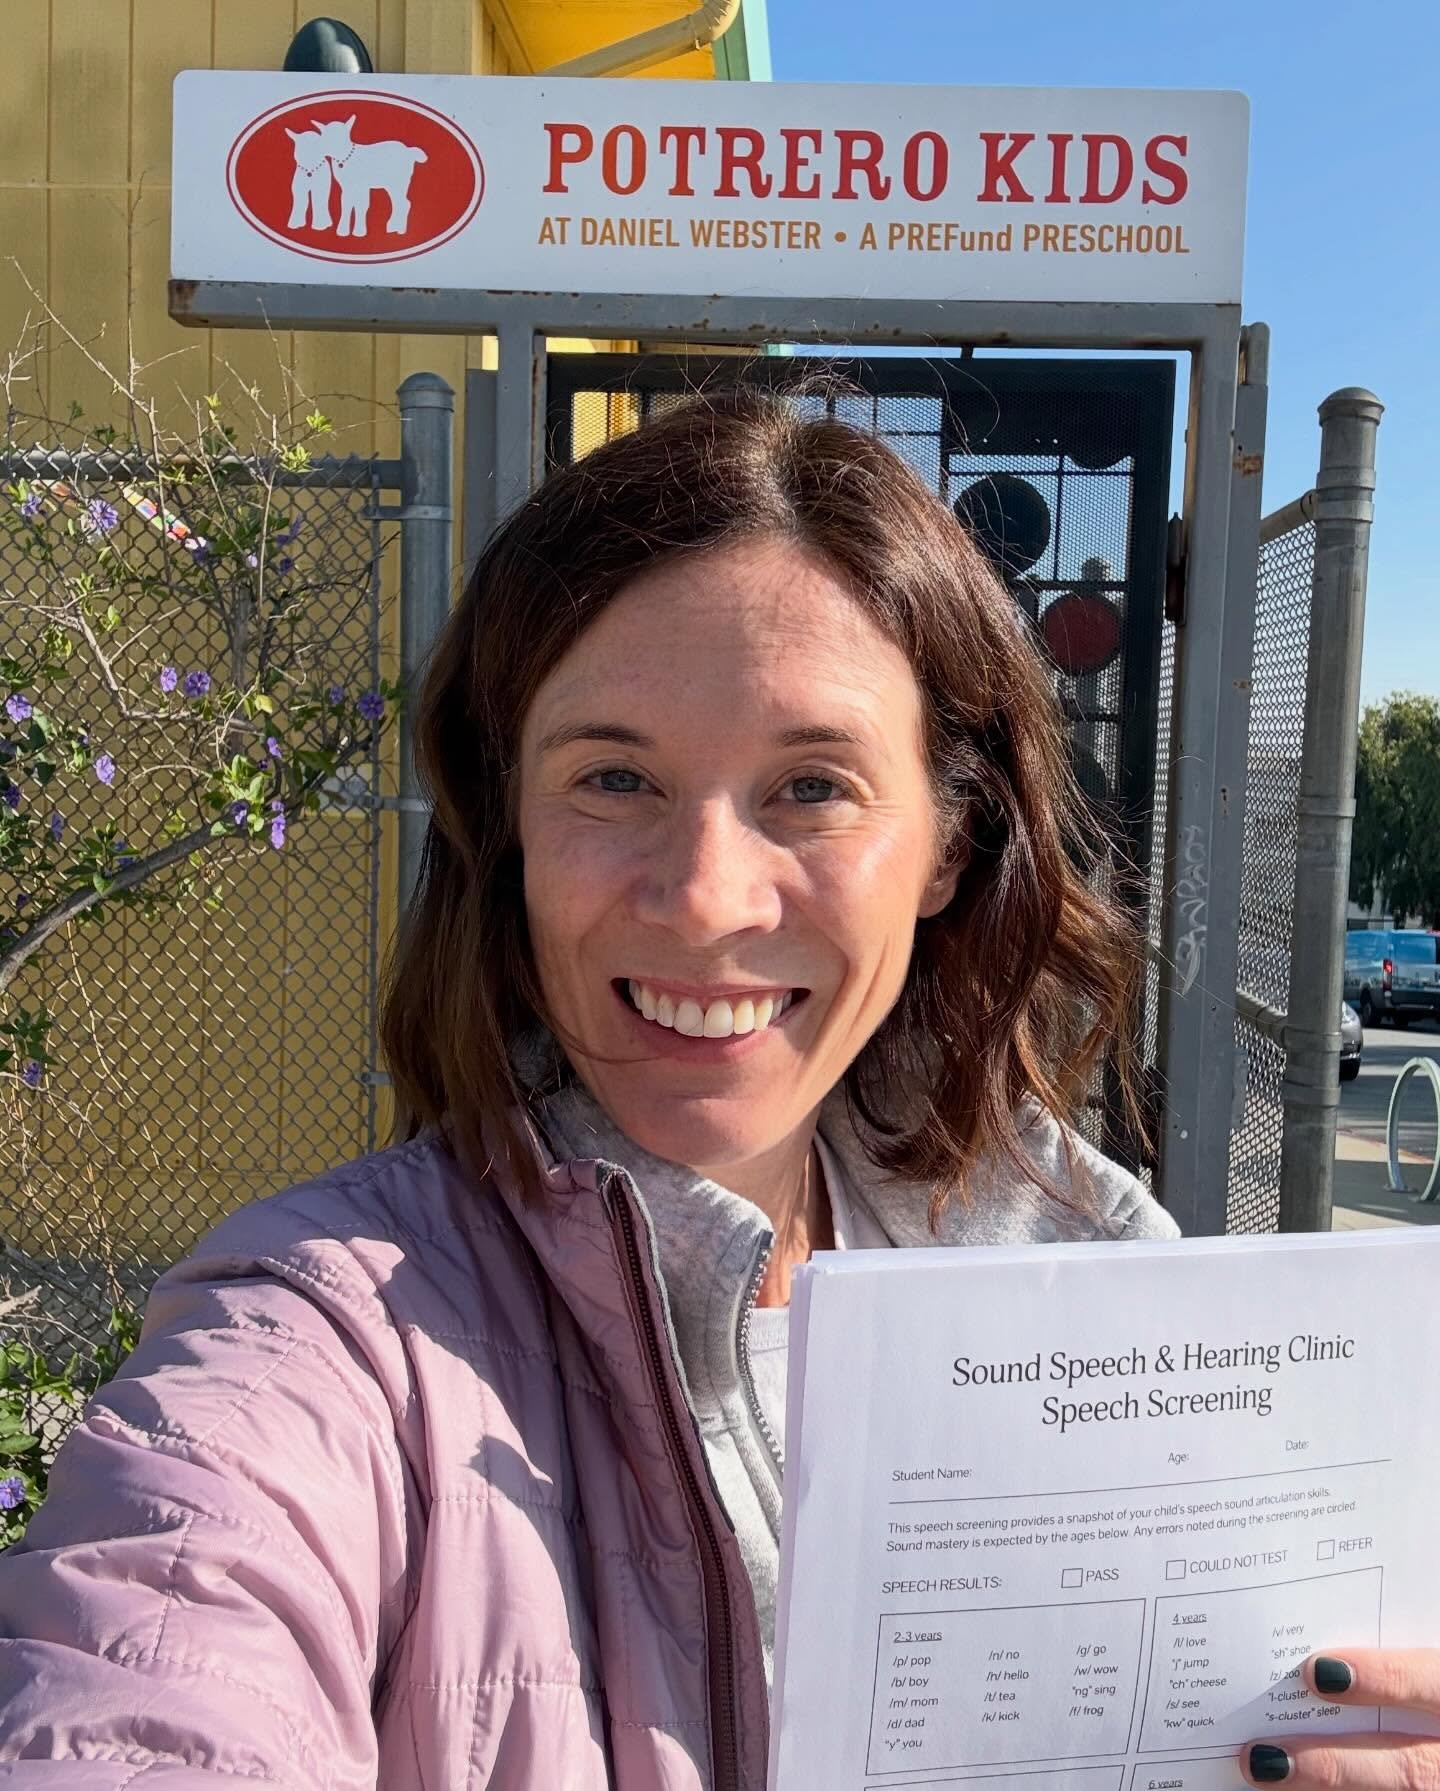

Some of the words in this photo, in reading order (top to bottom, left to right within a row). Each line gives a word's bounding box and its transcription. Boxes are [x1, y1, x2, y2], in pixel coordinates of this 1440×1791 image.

[542, 122, 949, 201] POTRERO
[976, 132, 1188, 205] KIDS
[538, 216, 571, 244] AT
[581, 217, 680, 247] DANIEL
[689, 219, 821, 249] WEBSTER
[859, 222, 877, 250] A
[888, 222, 1012, 252] PREFund
[1023, 223, 1190, 253] PRESCHOOL
[952, 1353, 1041, 1386] Sound
[1049, 1347, 1147, 1388] Speech
[1155, 1344, 1175, 1373] &
[1183, 1341, 1281, 1373] Hearing
[1288, 1334, 1355, 1362] Clinic
[1042, 1391, 1139, 1433] Speech
[1147, 1384, 1272, 1417] Screening
[1285, 1440, 1309, 1452] Date:
[1168, 1452, 1189, 1465] Age:
[892, 1468, 934, 1482] Student
[937, 1467, 972, 1479] Name:
[888, 1522, 911, 1534] This
[914, 1520, 953, 1534] speech
[956, 1516, 1008, 1531] screening
[1011, 1514, 1055, 1529] provides
[1058, 1515, 1064, 1525] a
[1067, 1510, 1114, 1524] snapshot
[1117, 1508, 1127, 1520] of
[1130, 1509, 1152, 1521] your
[1154, 1503, 1185, 1517] child's
[1187, 1501, 1222, 1515] speech
[1225, 1498, 1254, 1510] sound
[1255, 1491, 1305, 1506] articulation
[886, 1540, 923, 1552] Sound
[925, 1536, 969, 1551] mastery
[972, 1537, 981, 1547] is
[983, 1534, 1033, 1548] expected
[1035, 1532, 1048, 1545] by
[1051, 1531, 1068, 1543] the
[1070, 1532, 1096, 1545] ages
[1133, 1525, 1153, 1537] Any
[1156, 1524, 1184, 1535] errors
[1186, 1519, 1214, 1531] noted
[1216, 1514, 1246, 1529] during
[1249, 1512, 1264, 1524] the
[1265, 1507, 1309, 1522] screening
[1311, 1506, 1325, 1517] are
[1338, 1537, 1373, 1552] REFER
[1190, 1557, 1231, 1573] COULD
[1233, 1553, 1257, 1569] NOT
[1261, 1550, 1288, 1565] TEST
[1085, 1568, 1120, 1582] PASS
[882, 1580, 936, 1594] SPEECH
[939, 1576, 1002, 1591] RESULTS:
[1172, 1613, 1180, 1625] 4
[1181, 1613, 1207, 1625] years
[893, 1631, 913, 1643] 2-3
[915, 1631, 943, 1642] years
[1272, 1626, 1284, 1638] /v/
[1286, 1624, 1305, 1636] very
[1186, 1636, 1207, 1647] love
[988, 1650, 1004, 1661] /n/
[1006, 1651, 1020, 1660] no
[1076, 1645, 1092, 1658] /g/
[1093, 1645, 1107, 1657] go
[1290, 1644, 1312, 1656] shoe
[892, 1656, 907, 1668] /p/
[910, 1656, 931, 1668] pop
[1183, 1658, 1209, 1670] jump
[1004, 1670, 1029, 1681] hello
[1074, 1665, 1091, 1676] /w/
[1093, 1664, 1118, 1675] wow
[891, 1677, 906, 1688] /b/
[908, 1677, 929, 1689] boy
[1190, 1677, 1227, 1689] cheese
[1094, 1684, 1116, 1697] sing
[889, 1698, 908, 1709] /m/
[911, 1696, 939, 1707] mom
[984, 1692, 997, 1703] /t/
[999, 1691, 1016, 1701] tea
[1166, 1699, 1180, 1710] /s/
[1182, 1699, 1200, 1709] see
[982, 1711, 996, 1722] /k/
[998, 1710, 1020, 1721] kick
[1069, 1706, 1082, 1717] /f/
[1083, 1705, 1104, 1718] frog
[1317, 1705, 1341, 1717] sleep
[887, 1718, 902, 1729] /d/
[905, 1717, 925, 1728] dad
[1187, 1716, 1215, 1728] quick
[902, 1739, 923, 1751] you
[1148, 1780, 1156, 1790] 6
[1157, 1778, 1183, 1789] years
